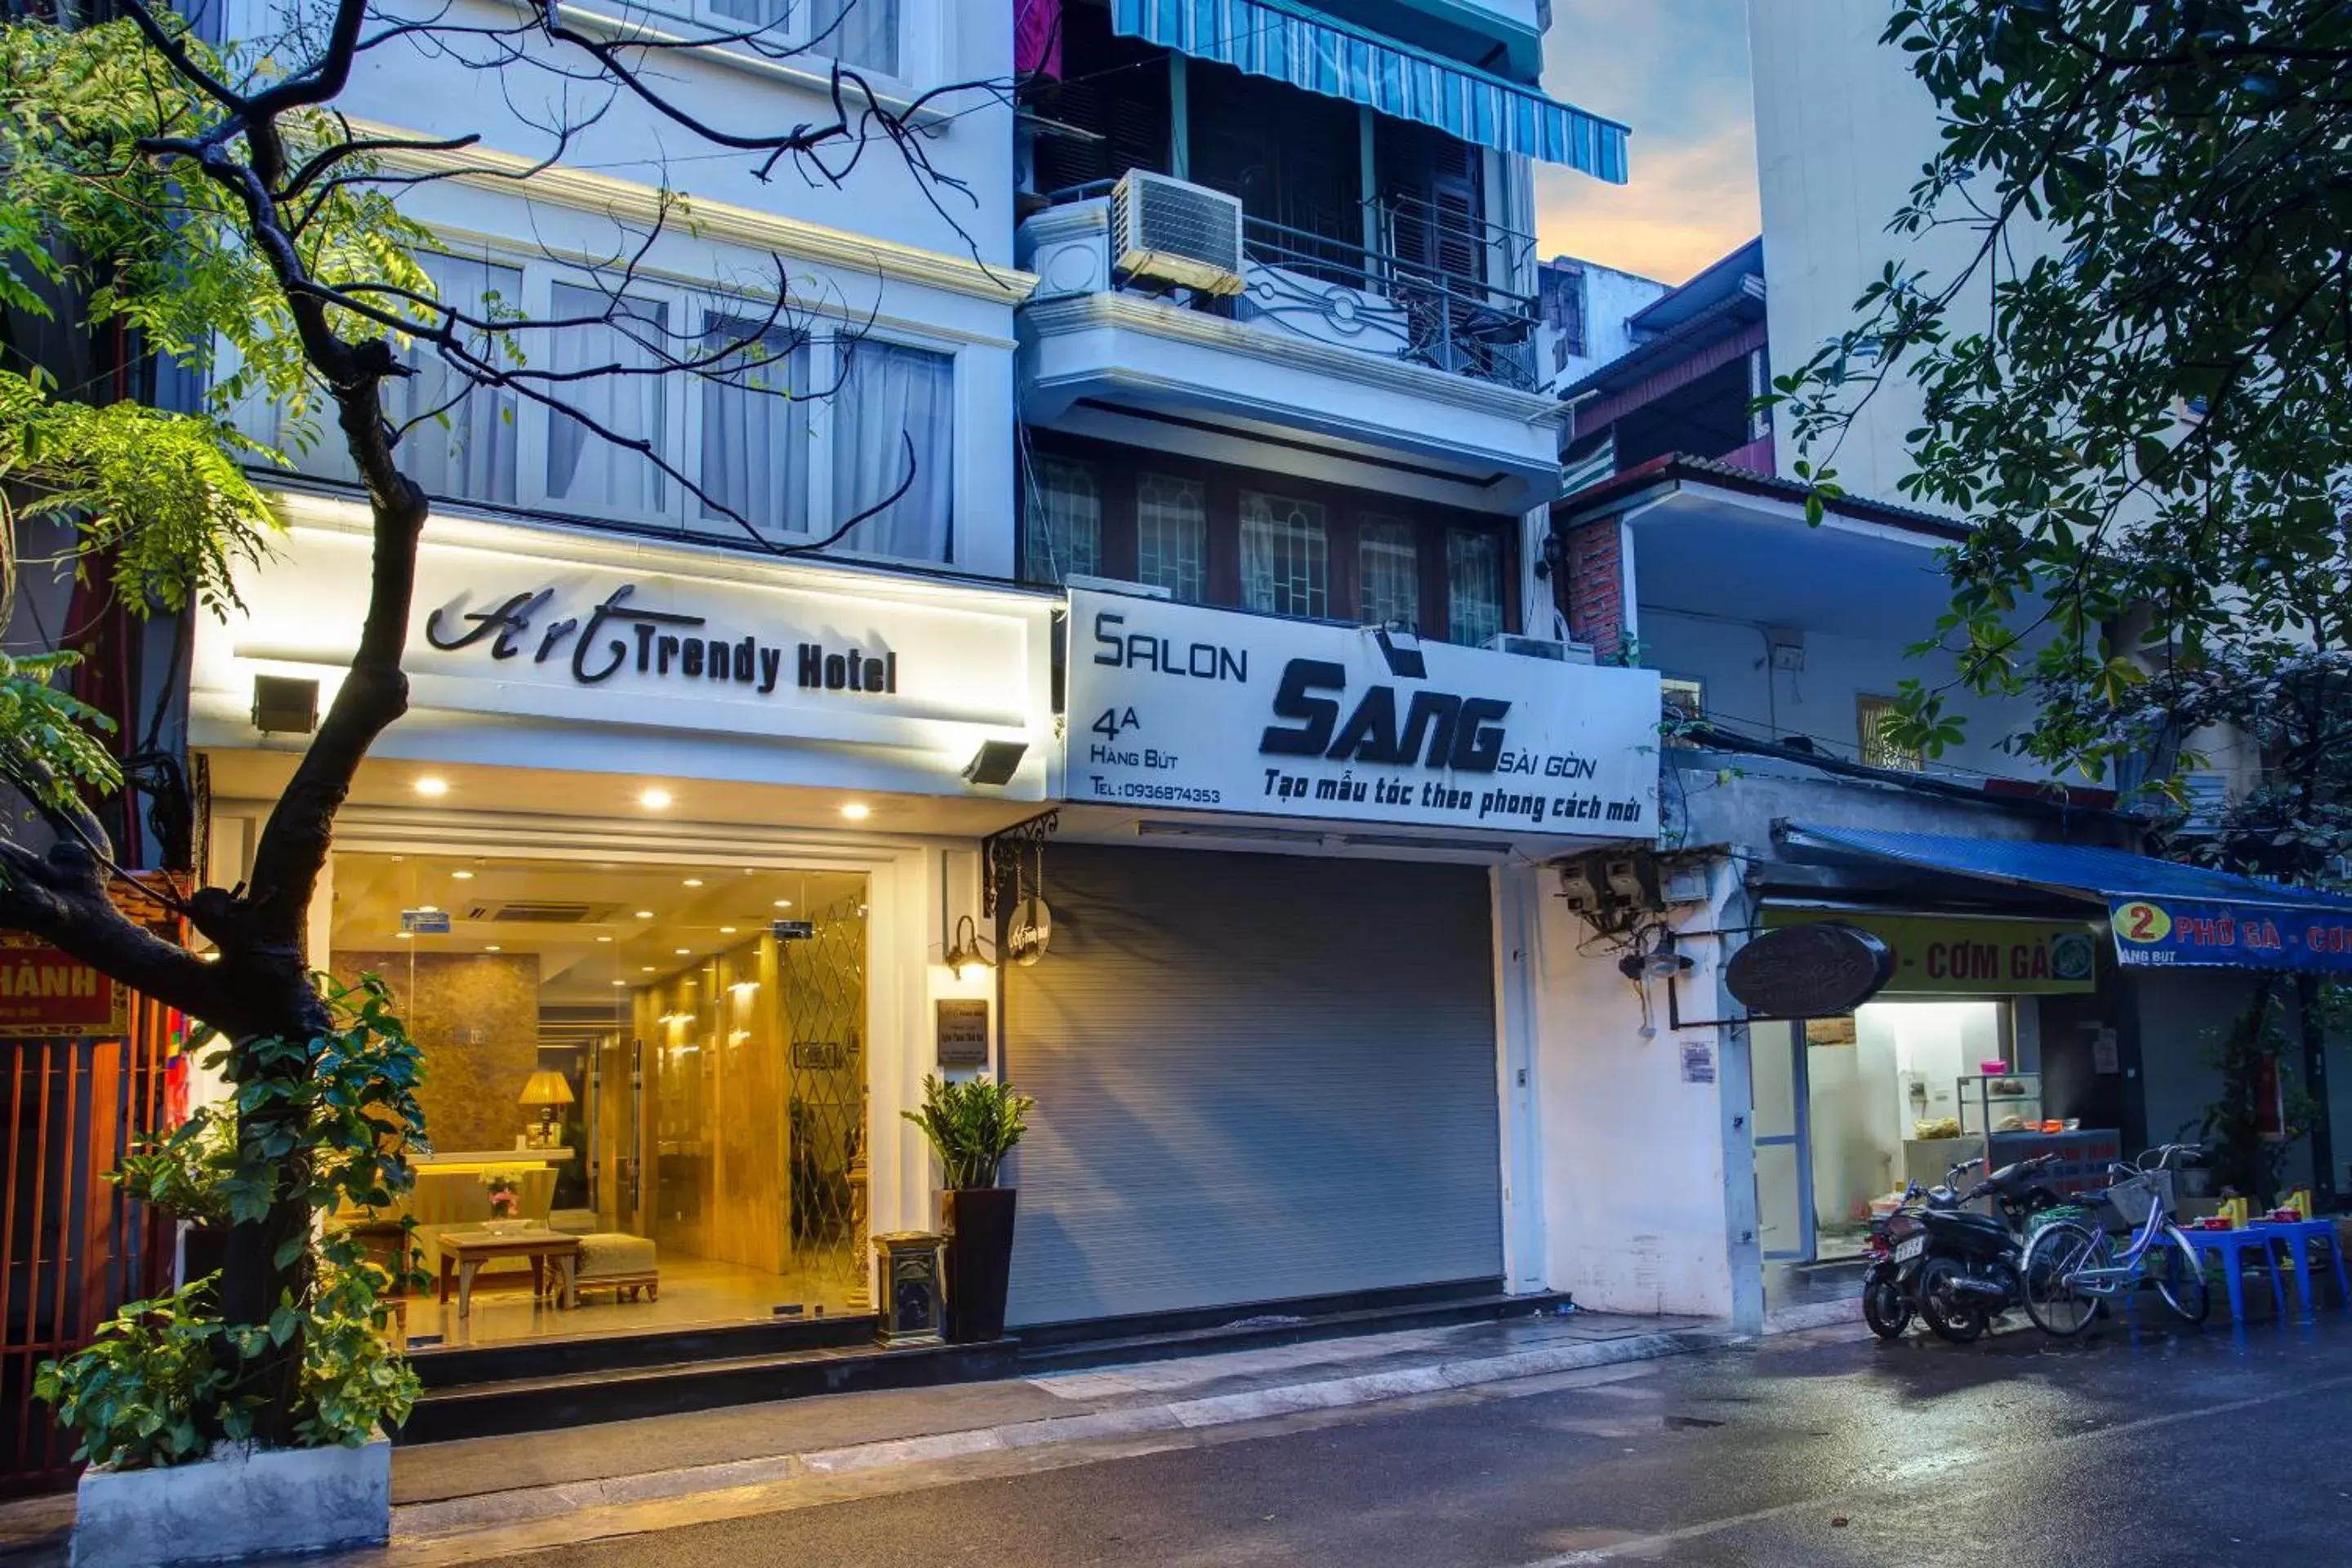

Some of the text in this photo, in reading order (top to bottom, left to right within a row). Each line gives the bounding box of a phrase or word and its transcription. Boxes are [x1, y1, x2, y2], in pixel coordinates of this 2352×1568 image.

[427, 584, 897, 694] Art Trendy Hotel
[1497, 747, 1597, 779] SÀI GÒN
[1265, 768, 1641, 822] Tạo mẫu tóc theo phong cách mới
[2130, 906, 2155, 940] 2
[1927, 940, 1999, 979] CƠM
